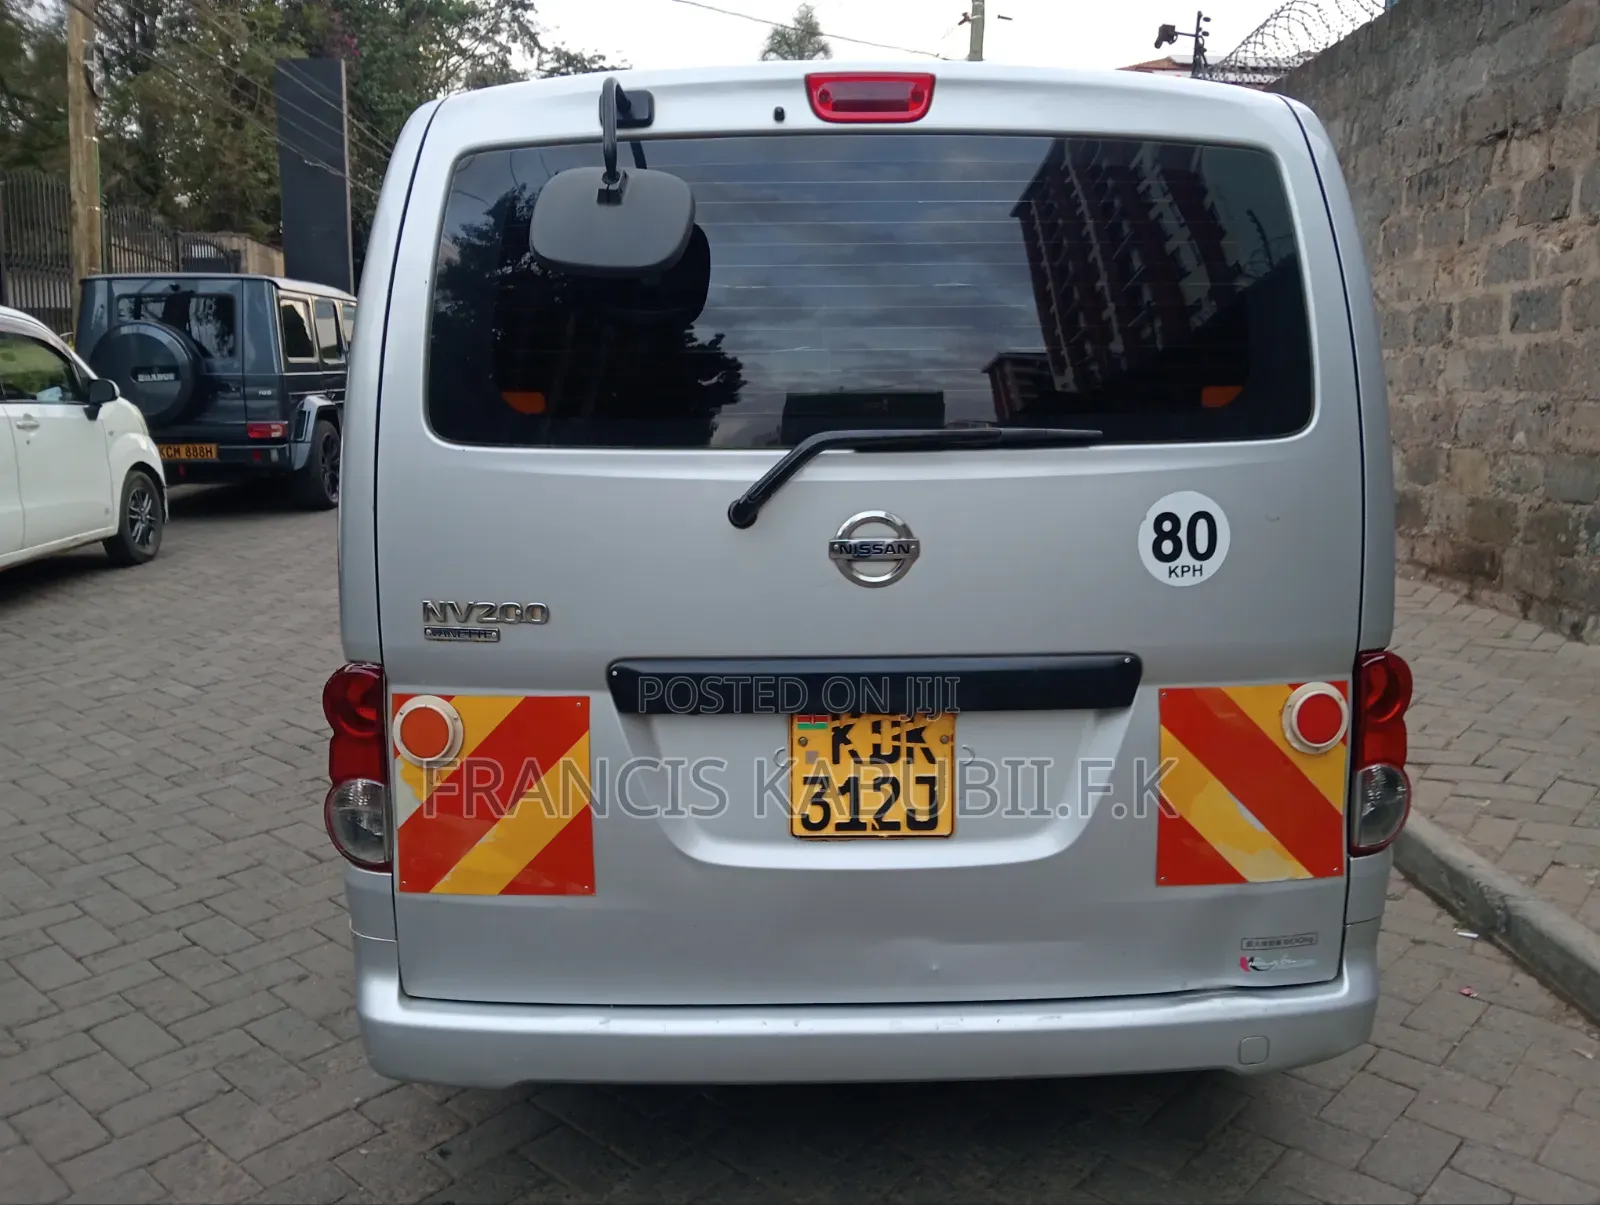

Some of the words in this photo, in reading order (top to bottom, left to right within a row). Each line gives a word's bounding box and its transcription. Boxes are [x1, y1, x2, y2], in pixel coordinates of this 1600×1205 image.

[160, 446, 180, 458] KCM
[185, 446, 213, 458] 888H
[1151, 510, 1218, 564] 80
[838, 543, 911, 556] NISSAN
[1168, 564, 1203, 579] KPH
[422, 600, 550, 625] NV200
[801, 776, 939, 831] 312J
